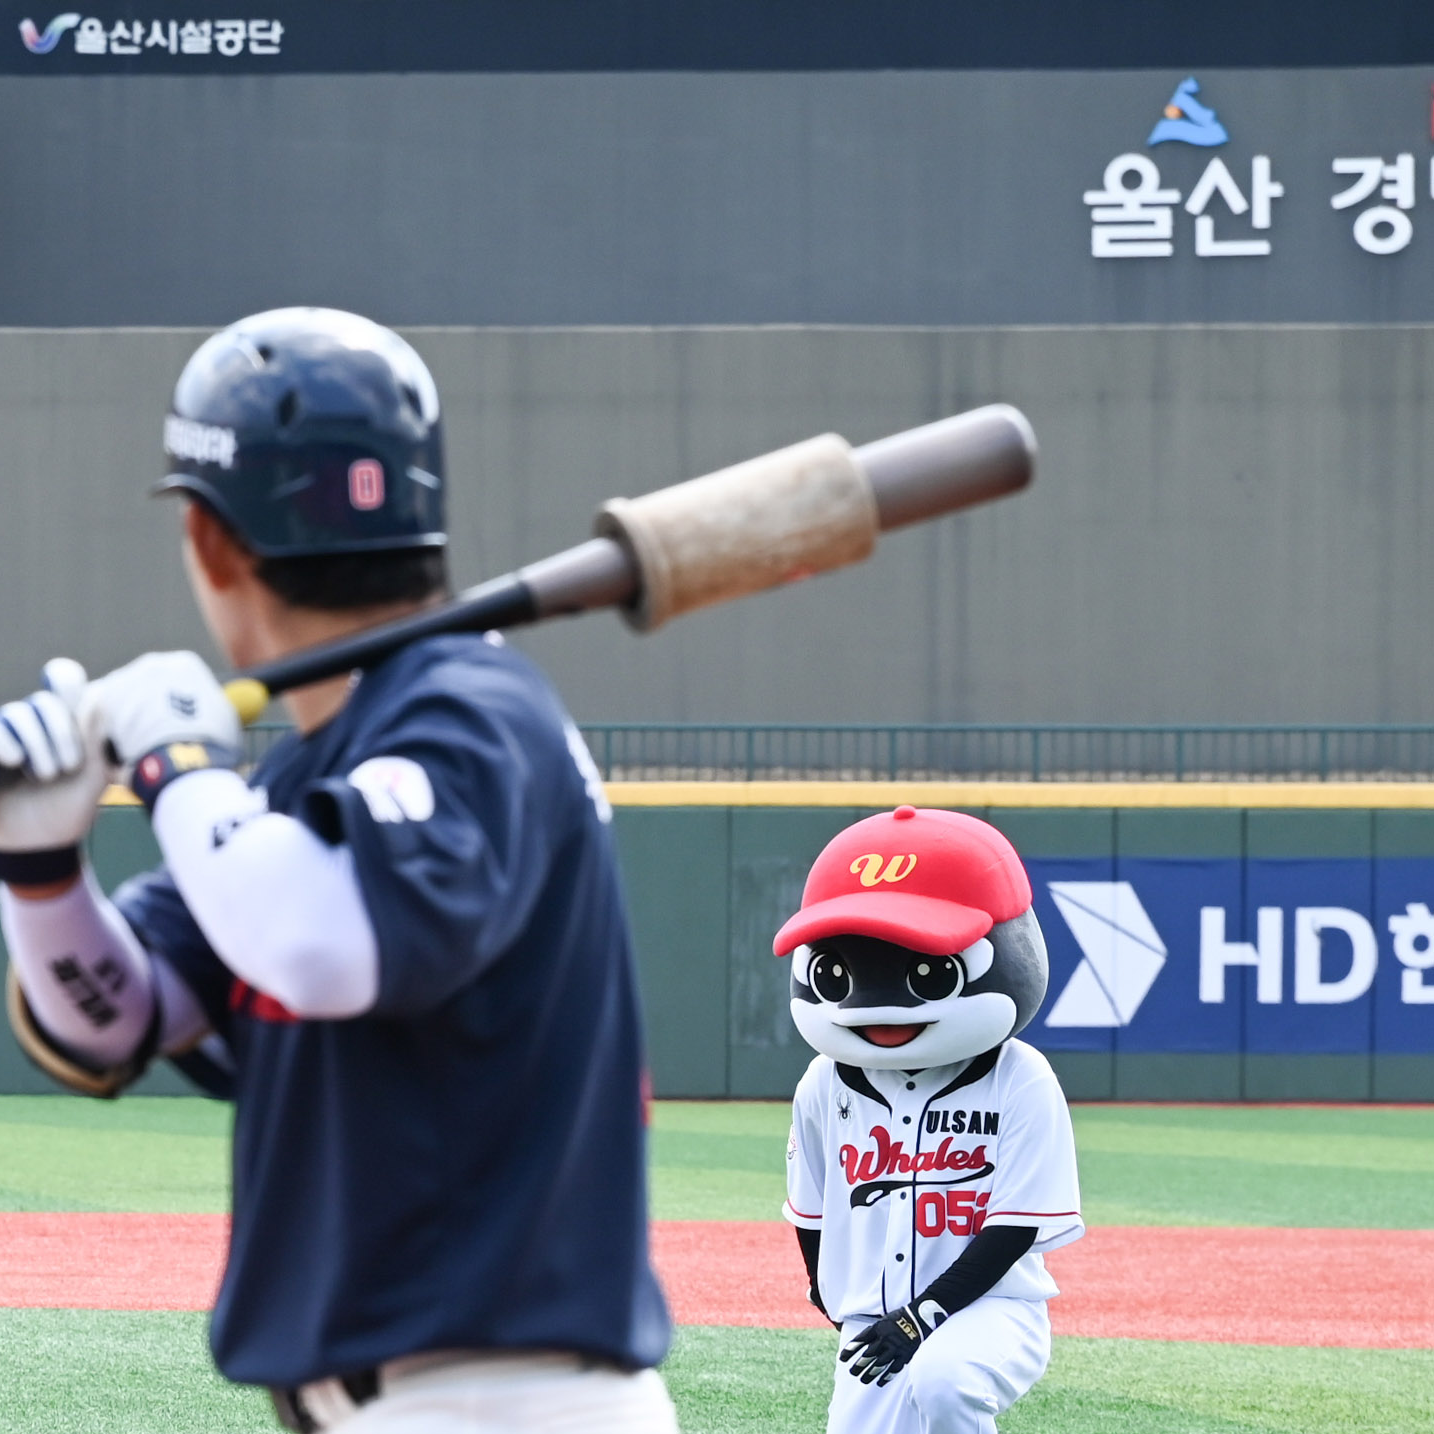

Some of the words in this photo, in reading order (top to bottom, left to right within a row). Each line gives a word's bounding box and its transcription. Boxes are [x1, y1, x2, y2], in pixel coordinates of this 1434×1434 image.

[74, 17, 284, 56] 울산시설공단
[1083, 152, 1284, 258] 울산
[1331, 152, 1434, 255] 경
[850, 853, 917, 887] W
[925, 1110, 999, 1135] ULSAN
[839, 1125, 987, 1185] Whales
